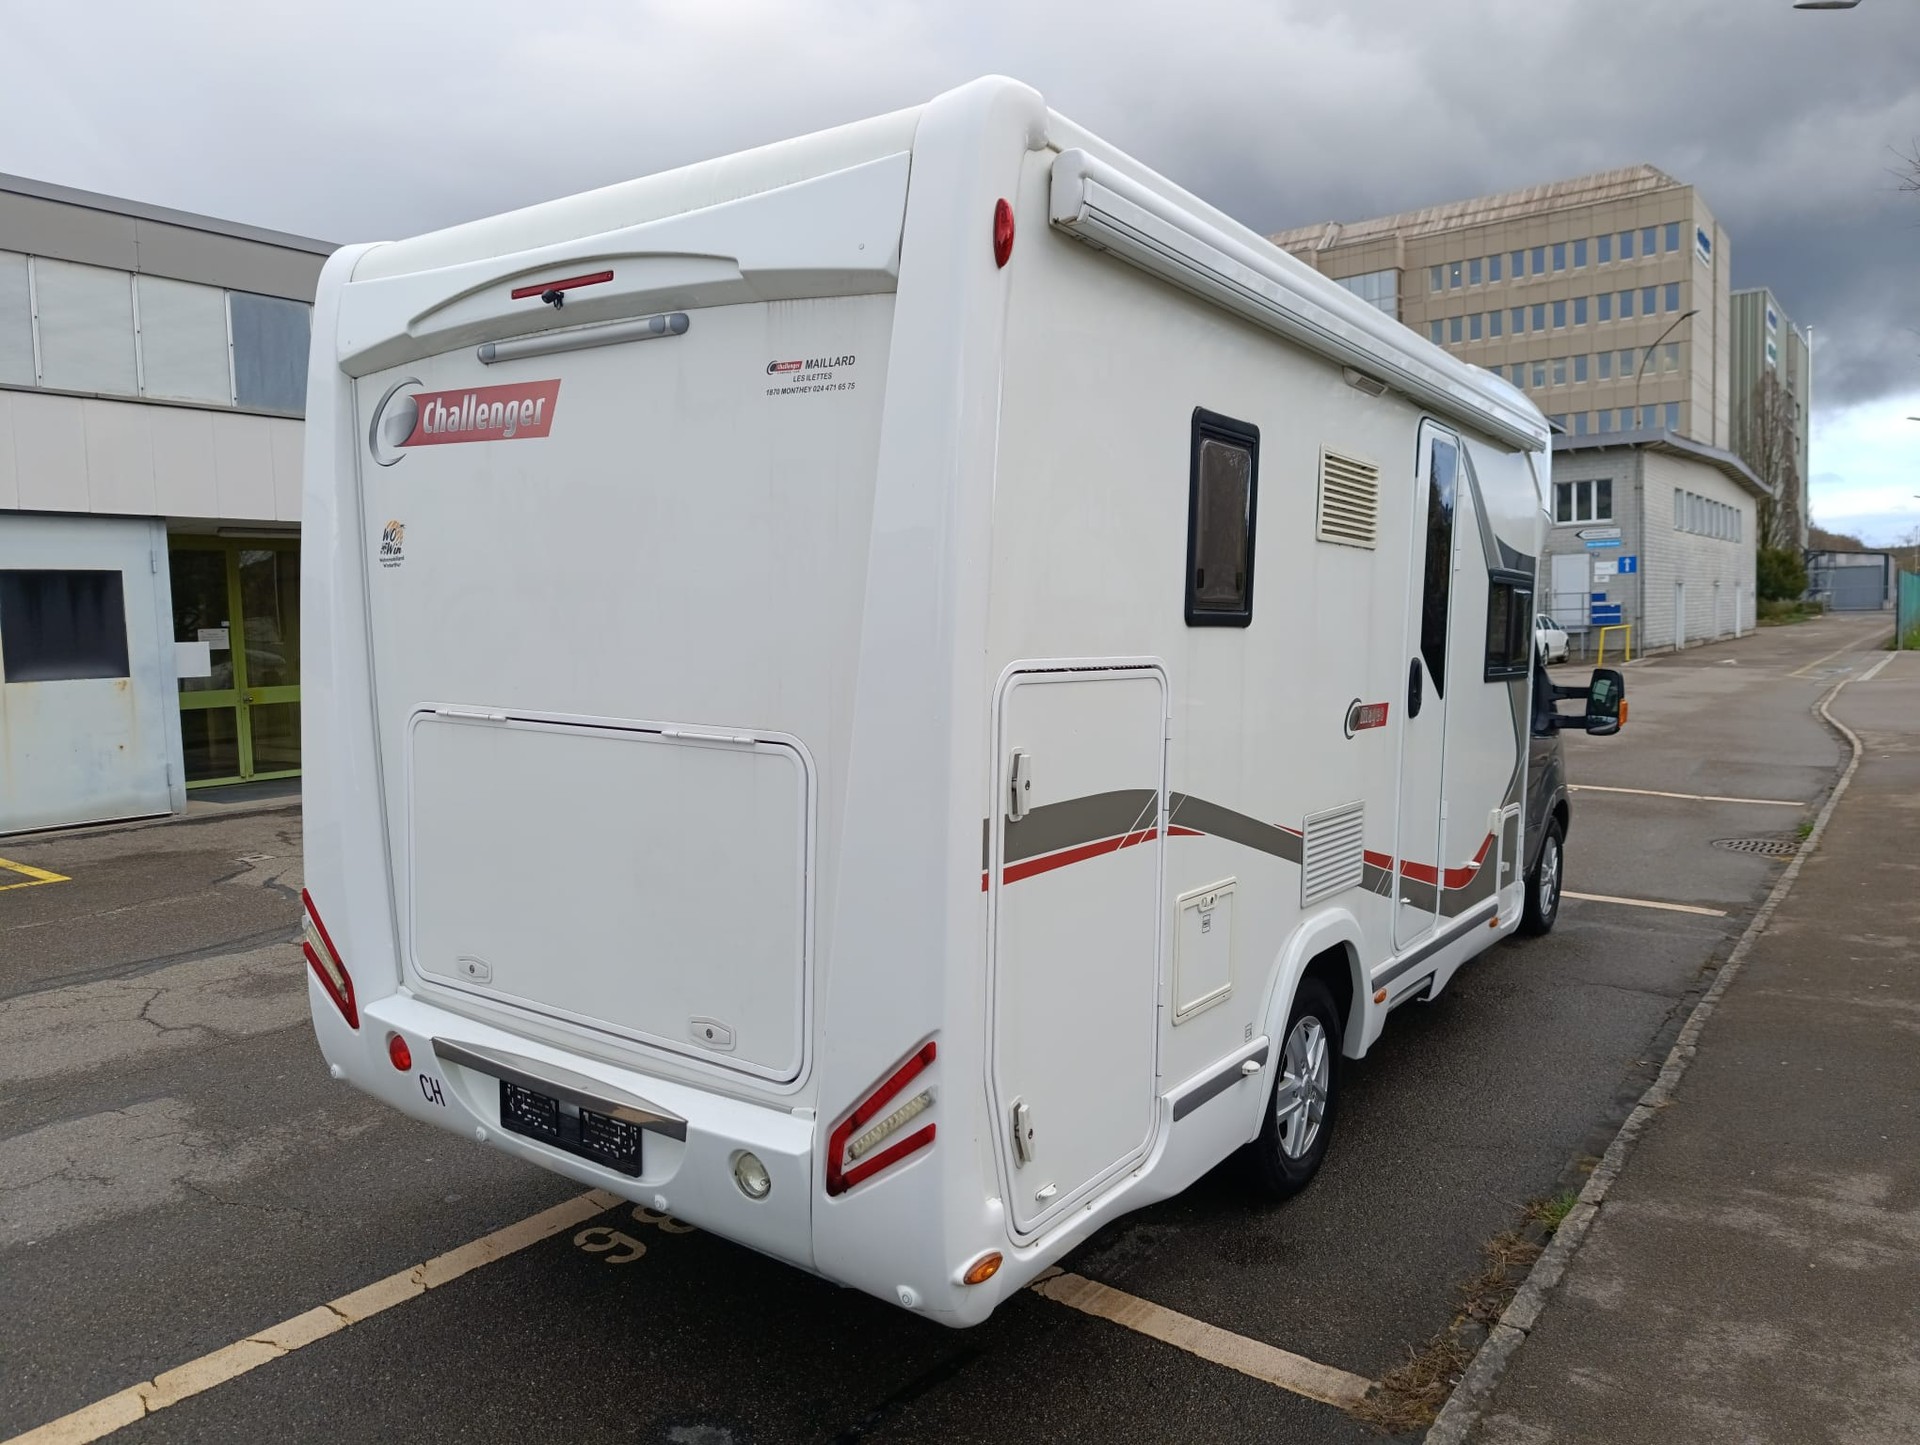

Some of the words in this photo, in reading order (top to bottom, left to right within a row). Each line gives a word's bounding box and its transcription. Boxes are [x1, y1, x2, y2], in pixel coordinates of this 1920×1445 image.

[804, 355, 856, 370] MAILLARD
[806, 372, 833, 381] ILETTES
[766, 388, 780, 396] 1870
[781, 386, 812, 395] MONTHEY
[847, 382, 855, 390] 75
[423, 393, 545, 438] Challenger
[420, 1074, 446, 1107] CH
